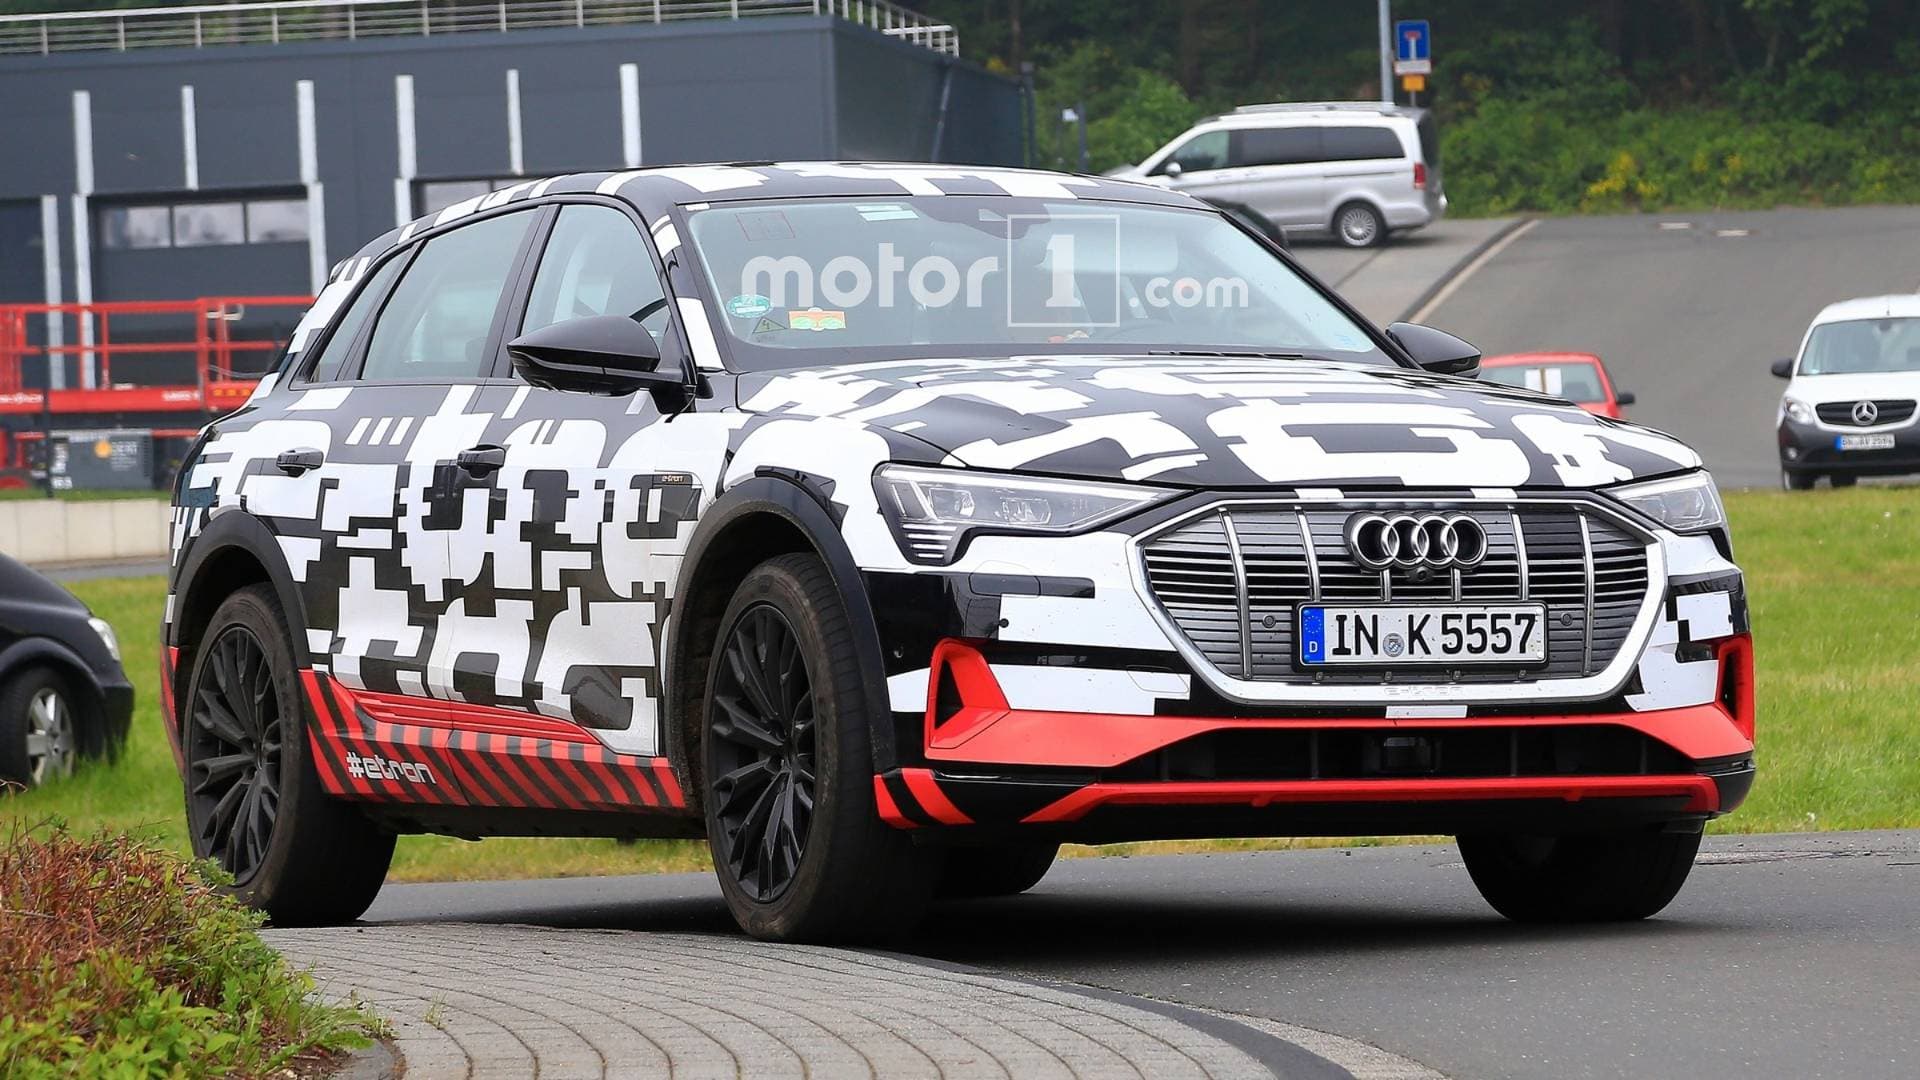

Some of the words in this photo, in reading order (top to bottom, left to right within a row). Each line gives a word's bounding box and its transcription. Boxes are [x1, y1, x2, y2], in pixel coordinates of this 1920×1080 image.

[1309, 642, 1318, 653] D
[1331, 613, 1379, 656] IN
[1407, 613, 1432, 655] K
[1441, 613, 1537, 655] 5557
